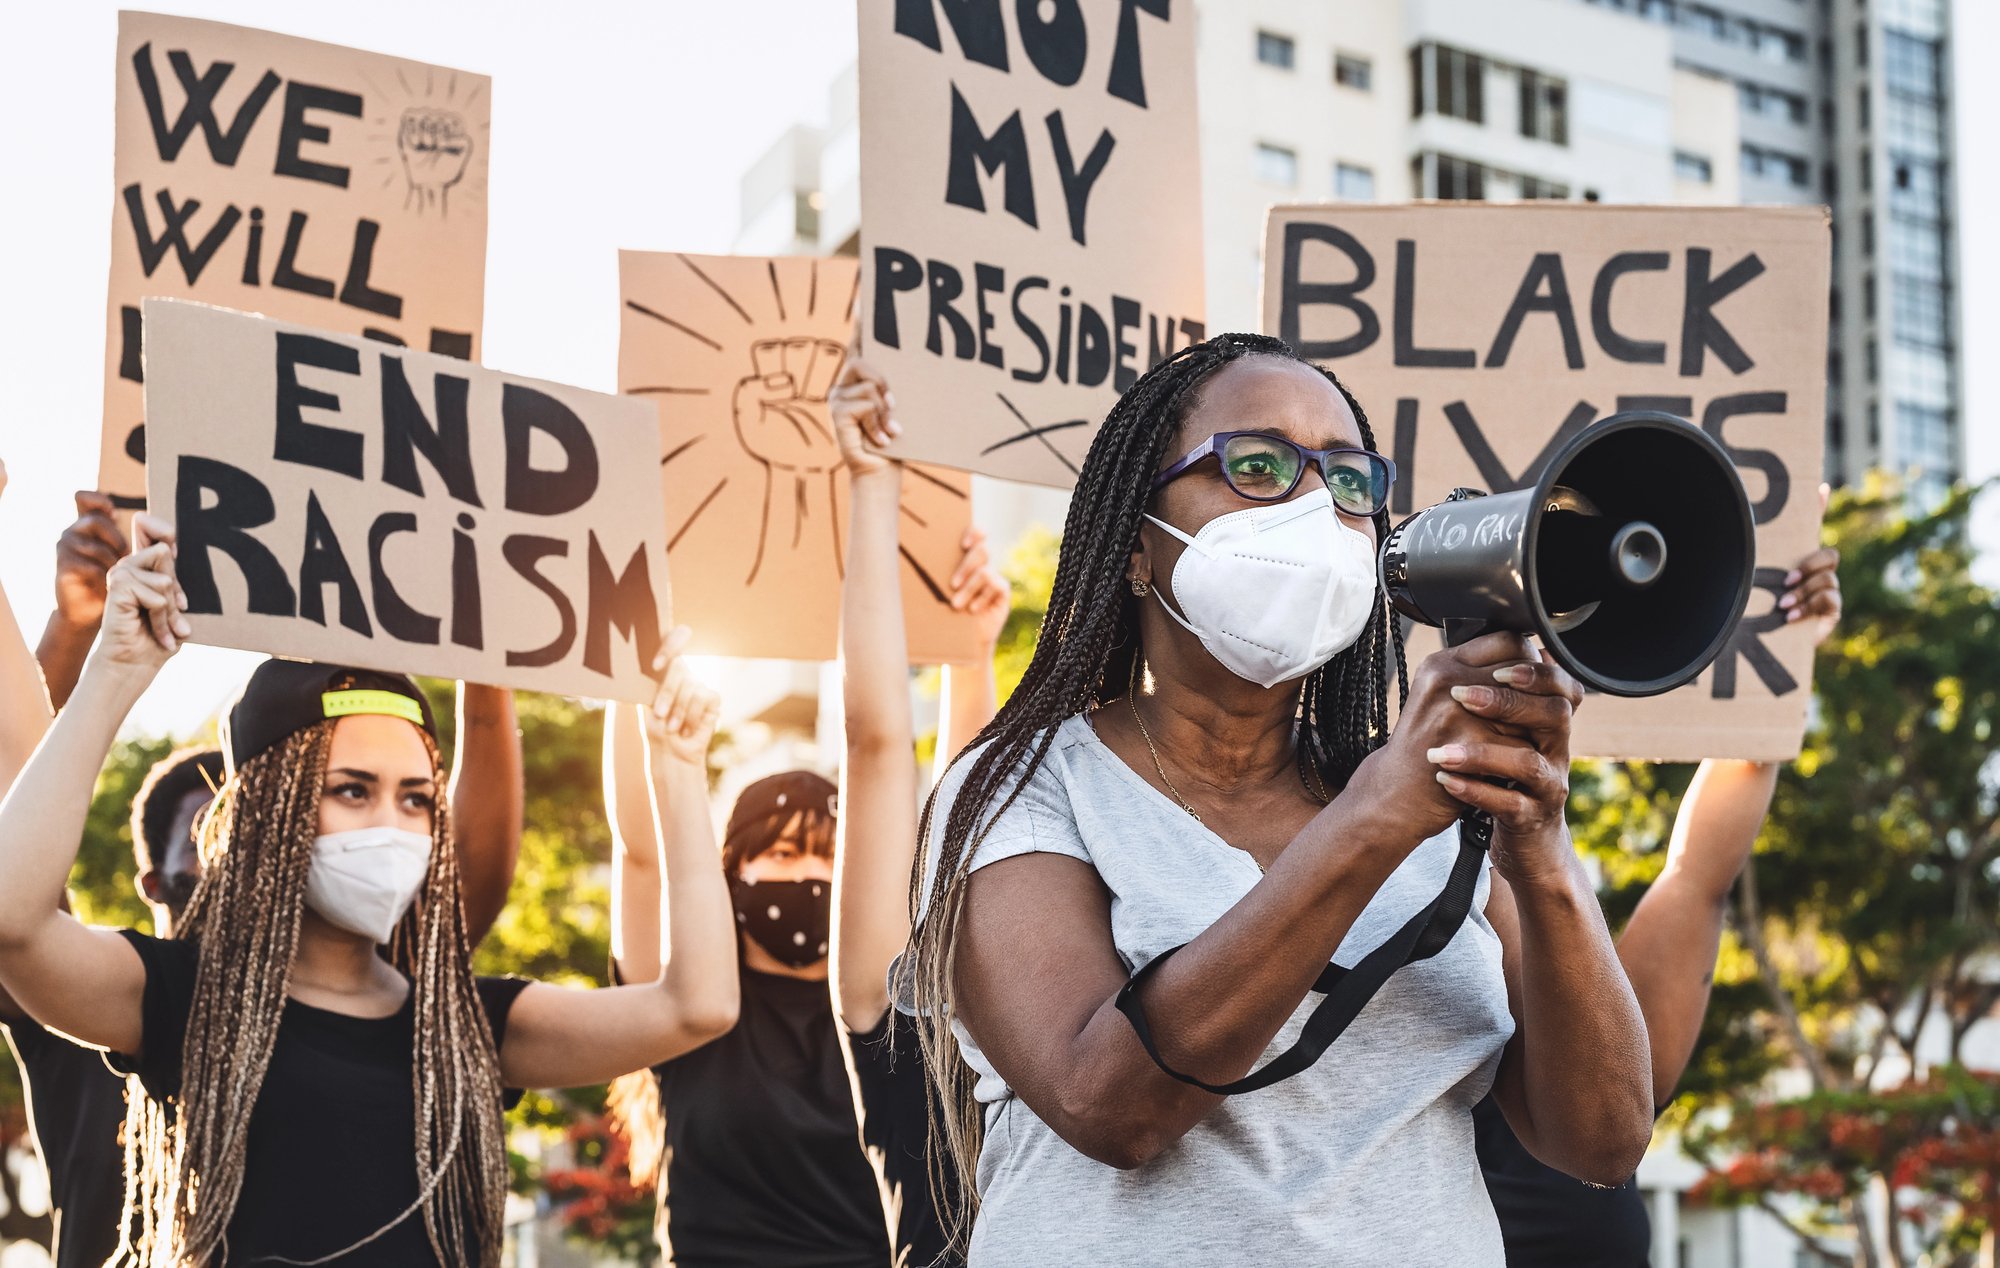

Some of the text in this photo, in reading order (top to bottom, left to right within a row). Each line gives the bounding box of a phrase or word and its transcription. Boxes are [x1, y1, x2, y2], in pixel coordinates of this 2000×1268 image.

[132, 41, 364, 190] WE
[894, 0, 1170, 110] NOT
[945, 78, 1117, 248] MY
[1279, 221, 1766, 377] BLACK
[273, 331, 600, 517] END
[1391, 391, 1792, 527] IVS
